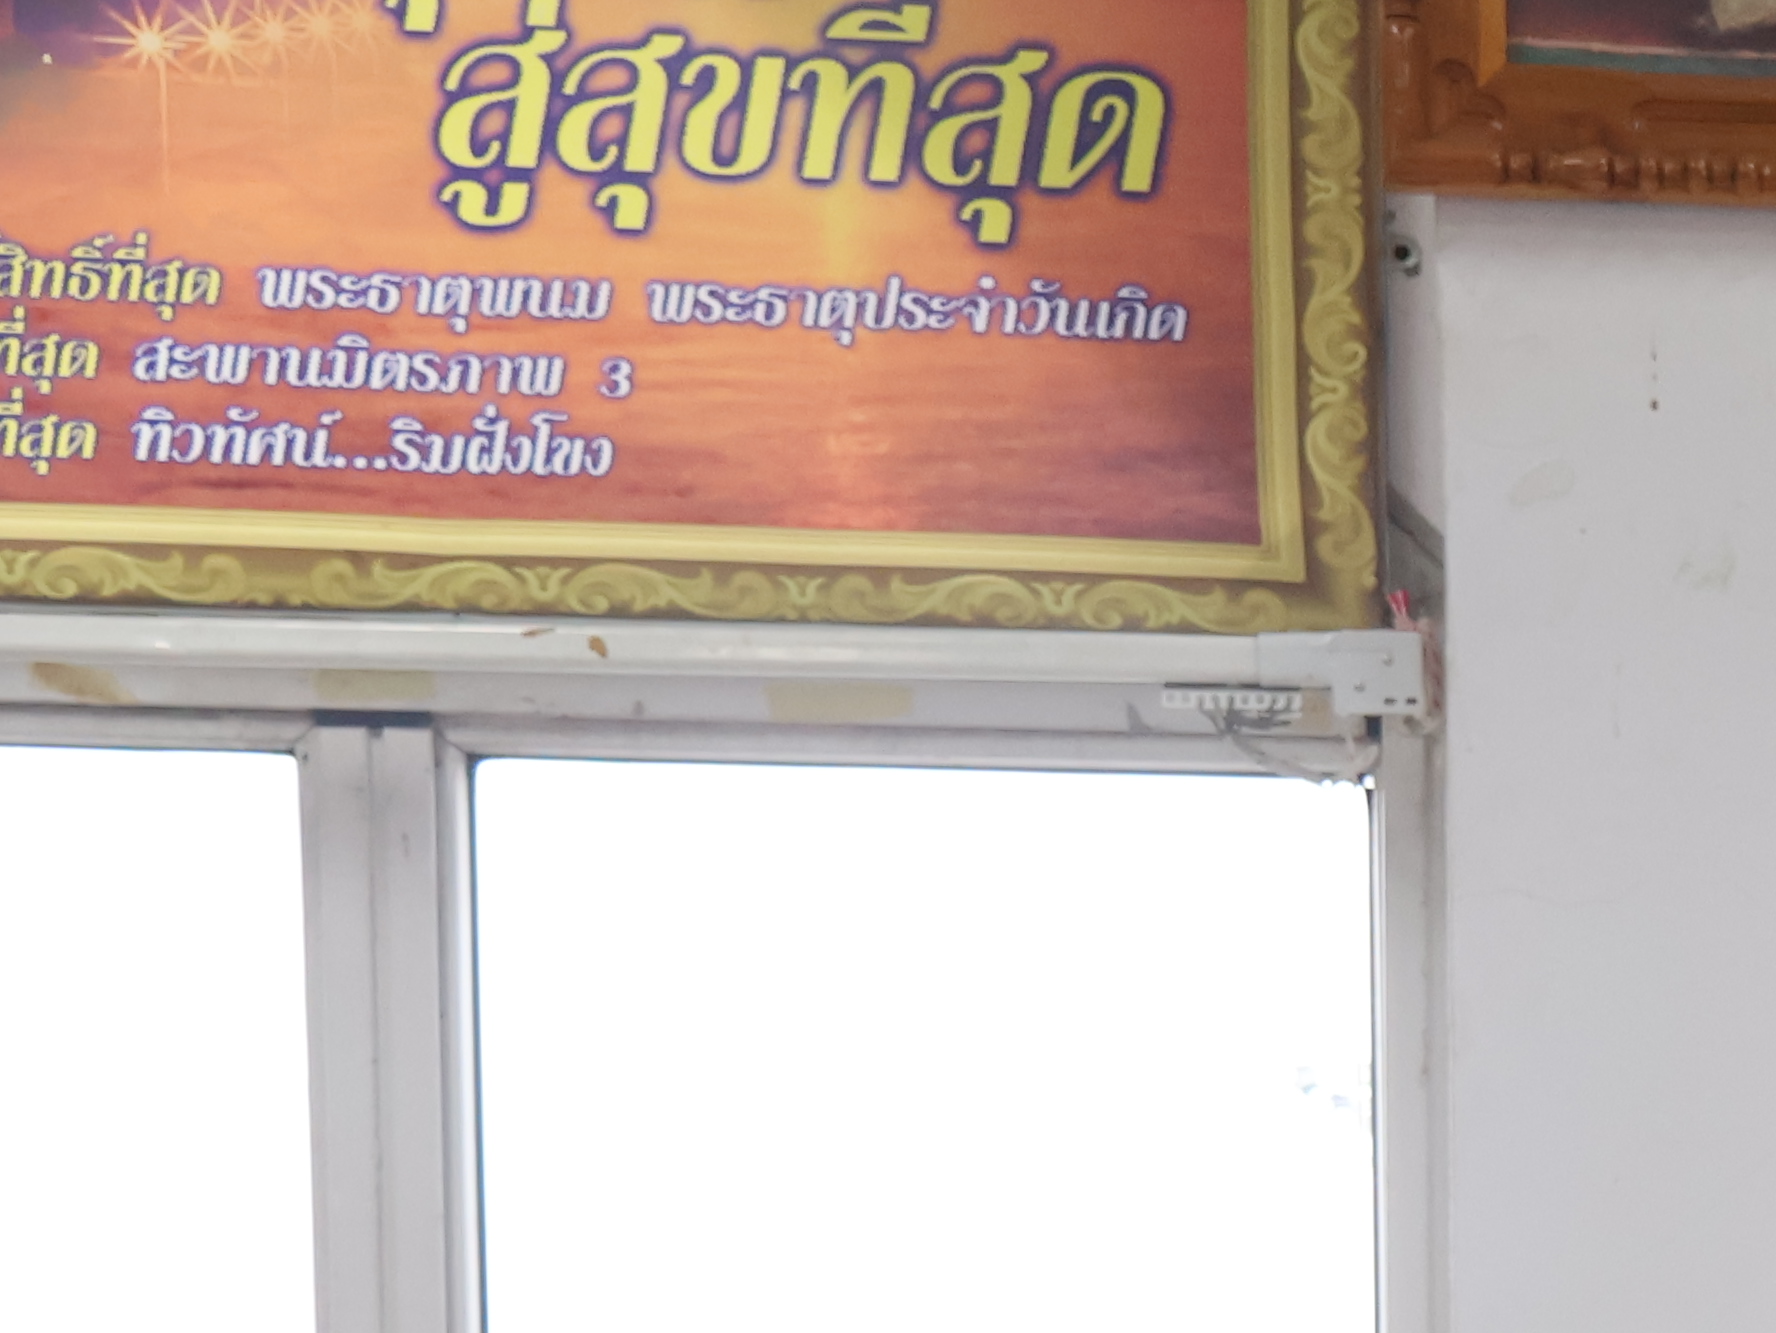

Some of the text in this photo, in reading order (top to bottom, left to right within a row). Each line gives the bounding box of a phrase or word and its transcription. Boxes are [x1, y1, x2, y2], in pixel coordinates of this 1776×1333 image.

[257, 264, 613, 334] พระธาตุพนม
[645, 274, 1189, 347] พระธาตุประจำวันเกิด
[132, 333, 565, 396] สะพานมิตรภาพ
[600, 357, 634, 399] 3
[131, 405, 614, 477] ทิวทัศน์...ริมฝั่งโขง
